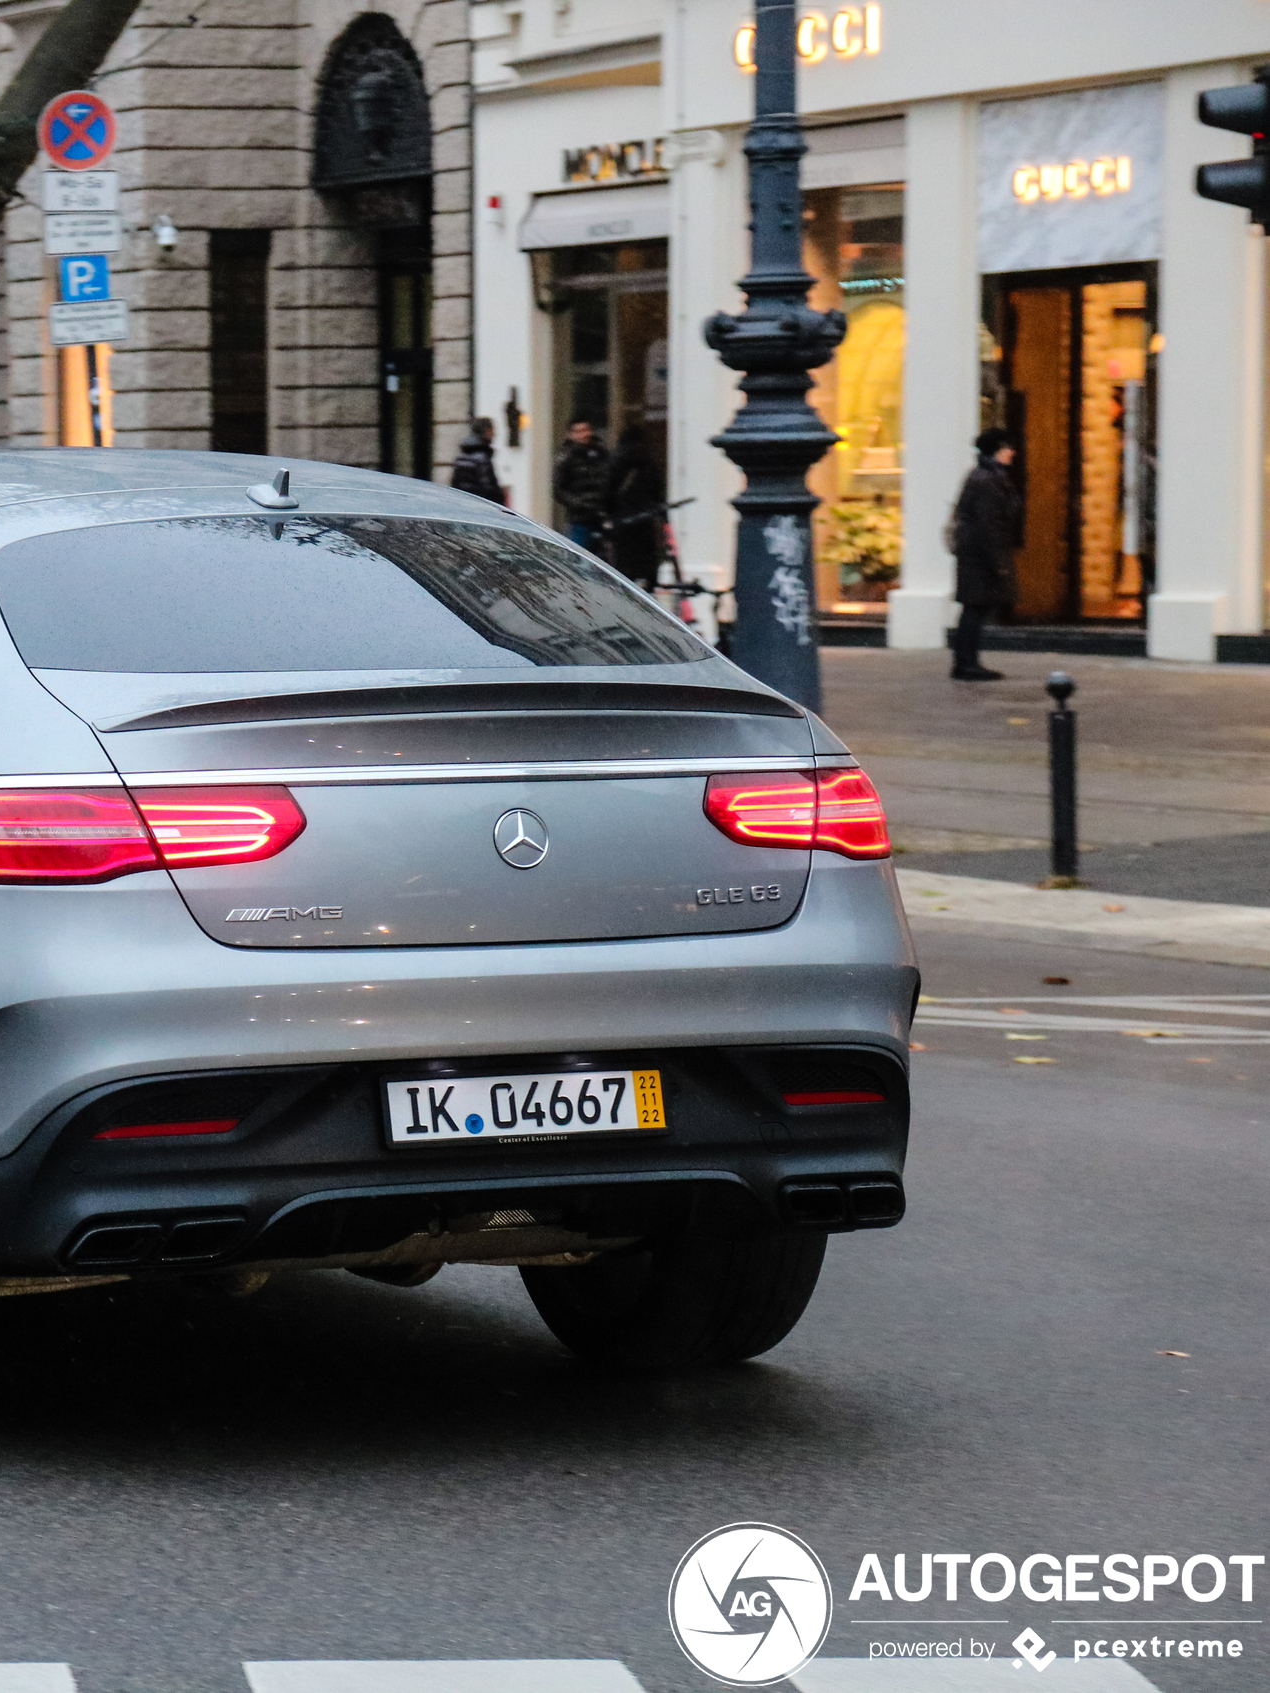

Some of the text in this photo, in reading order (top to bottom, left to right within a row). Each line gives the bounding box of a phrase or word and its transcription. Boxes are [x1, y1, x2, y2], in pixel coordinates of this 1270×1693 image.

[734, 5, 881, 73] GCCI
[1013, 155, 1132, 204] GUCCI
[67, 260, 96, 297] P
[696, 883, 781, 905] GLE 63
[262, 905, 343, 921] AMG
[638, 1076, 657, 1089] 22
[406, 1077, 626, 1134] IK 04667
[641, 1093, 657, 1106] 11
[642, 1109, 661, 1123] 22
